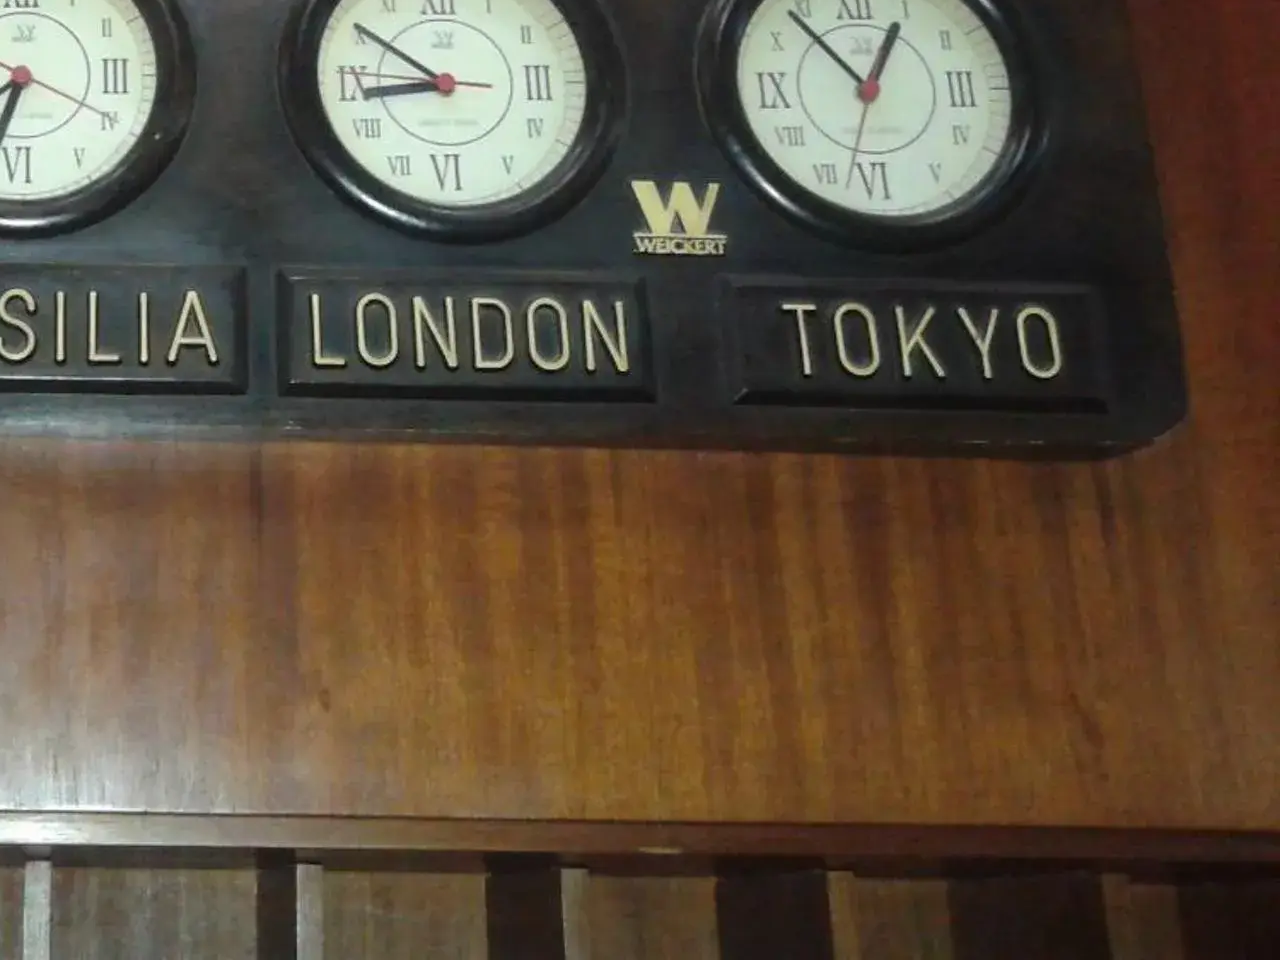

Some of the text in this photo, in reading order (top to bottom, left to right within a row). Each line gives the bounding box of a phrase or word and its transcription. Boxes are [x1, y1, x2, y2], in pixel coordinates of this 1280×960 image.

[102, 58, 129, 94] III
[524, 65, 553, 101] III
[756, 72, 791, 109] IX
[945, 71, 977, 107] III
[1, 147, 32, 184] VI
[430, 154, 462, 191] VI
[855, 162, 892, 200] VI
[310, 292, 628, 372] LONDON
[781, 301, 1063, 379] TOKYO
